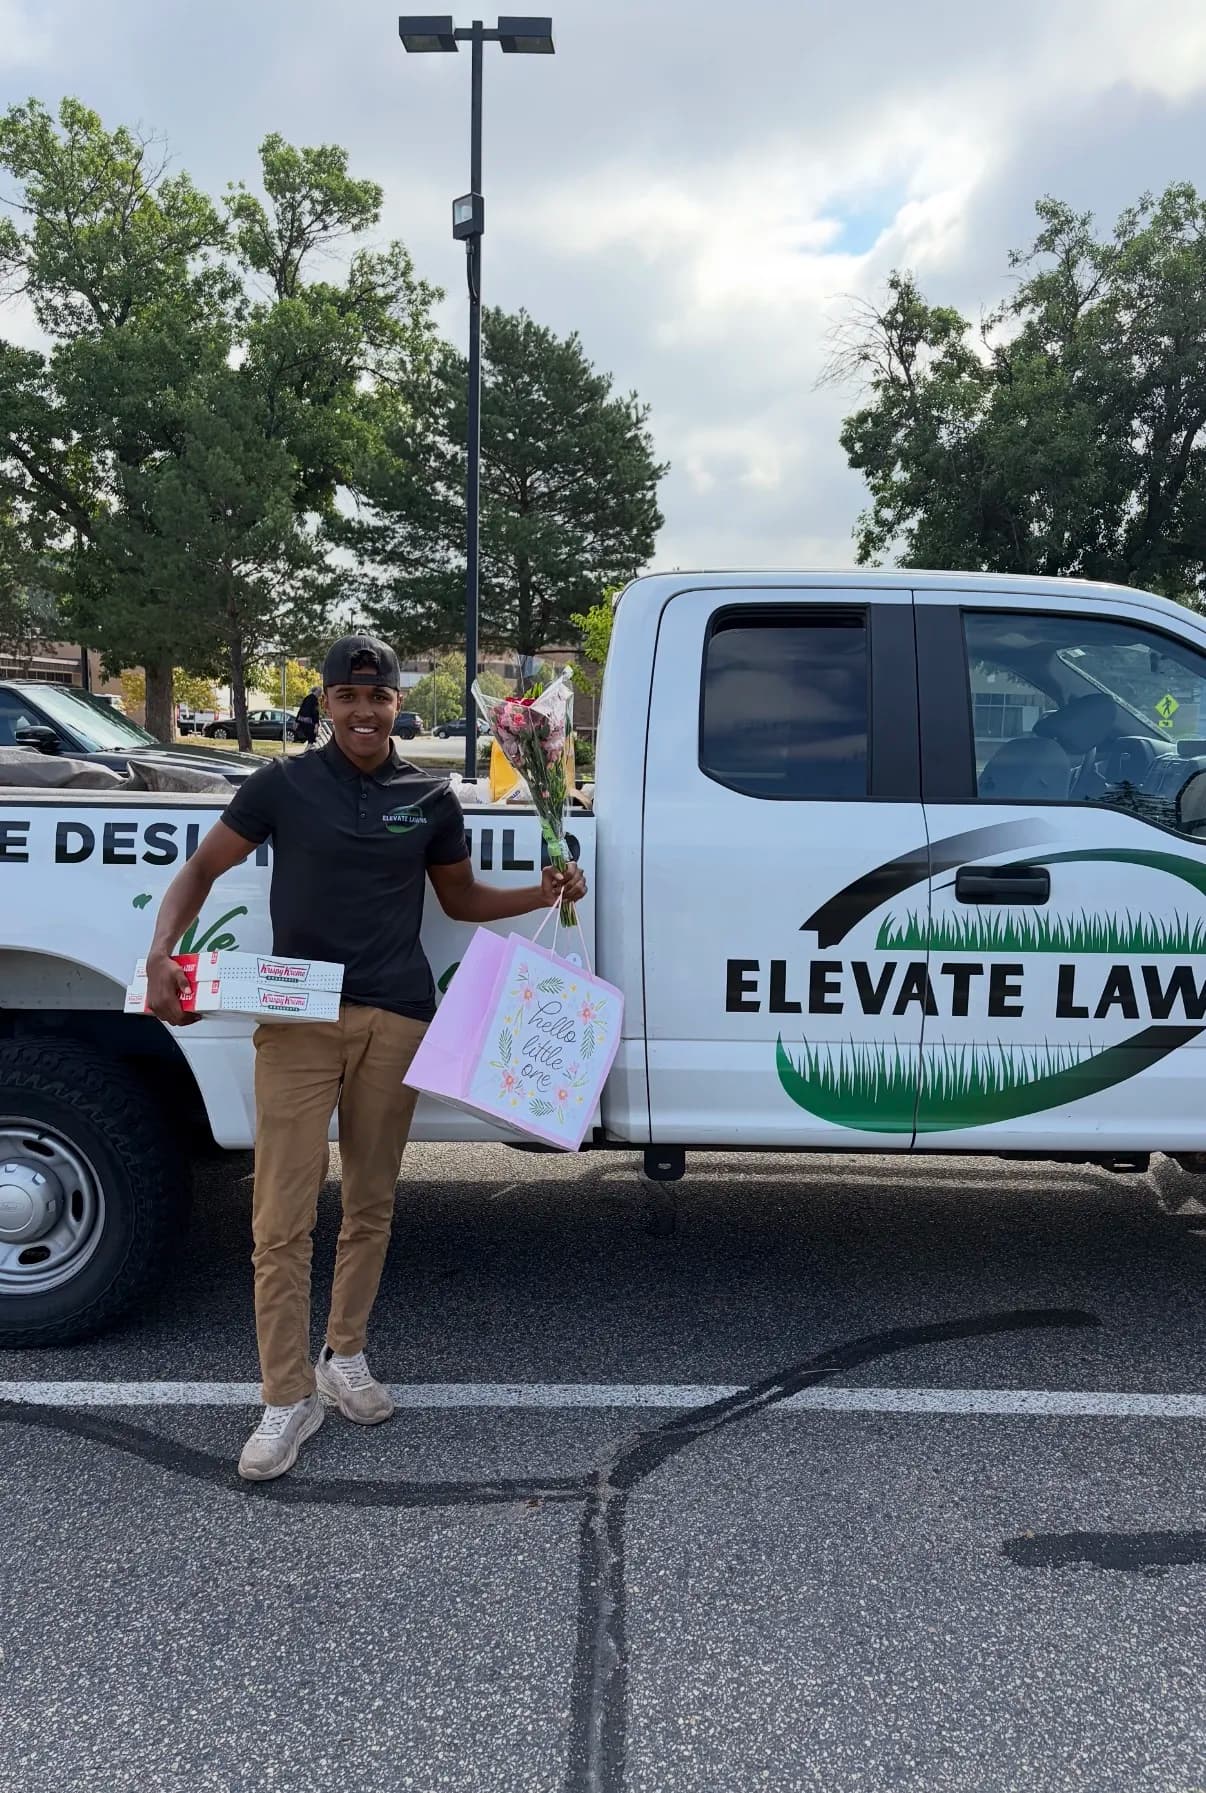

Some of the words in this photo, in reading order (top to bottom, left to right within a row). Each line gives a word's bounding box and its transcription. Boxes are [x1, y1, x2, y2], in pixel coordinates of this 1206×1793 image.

[55, 822, 272, 867] DESI
[726, 959, 1024, 1017] ELEVATE
[1056, 964, 1206, 1019] LAW
[528, 1001, 576, 1043] hello
[522, 1035, 563, 1070] little
[521, 1063, 551, 1092] one
